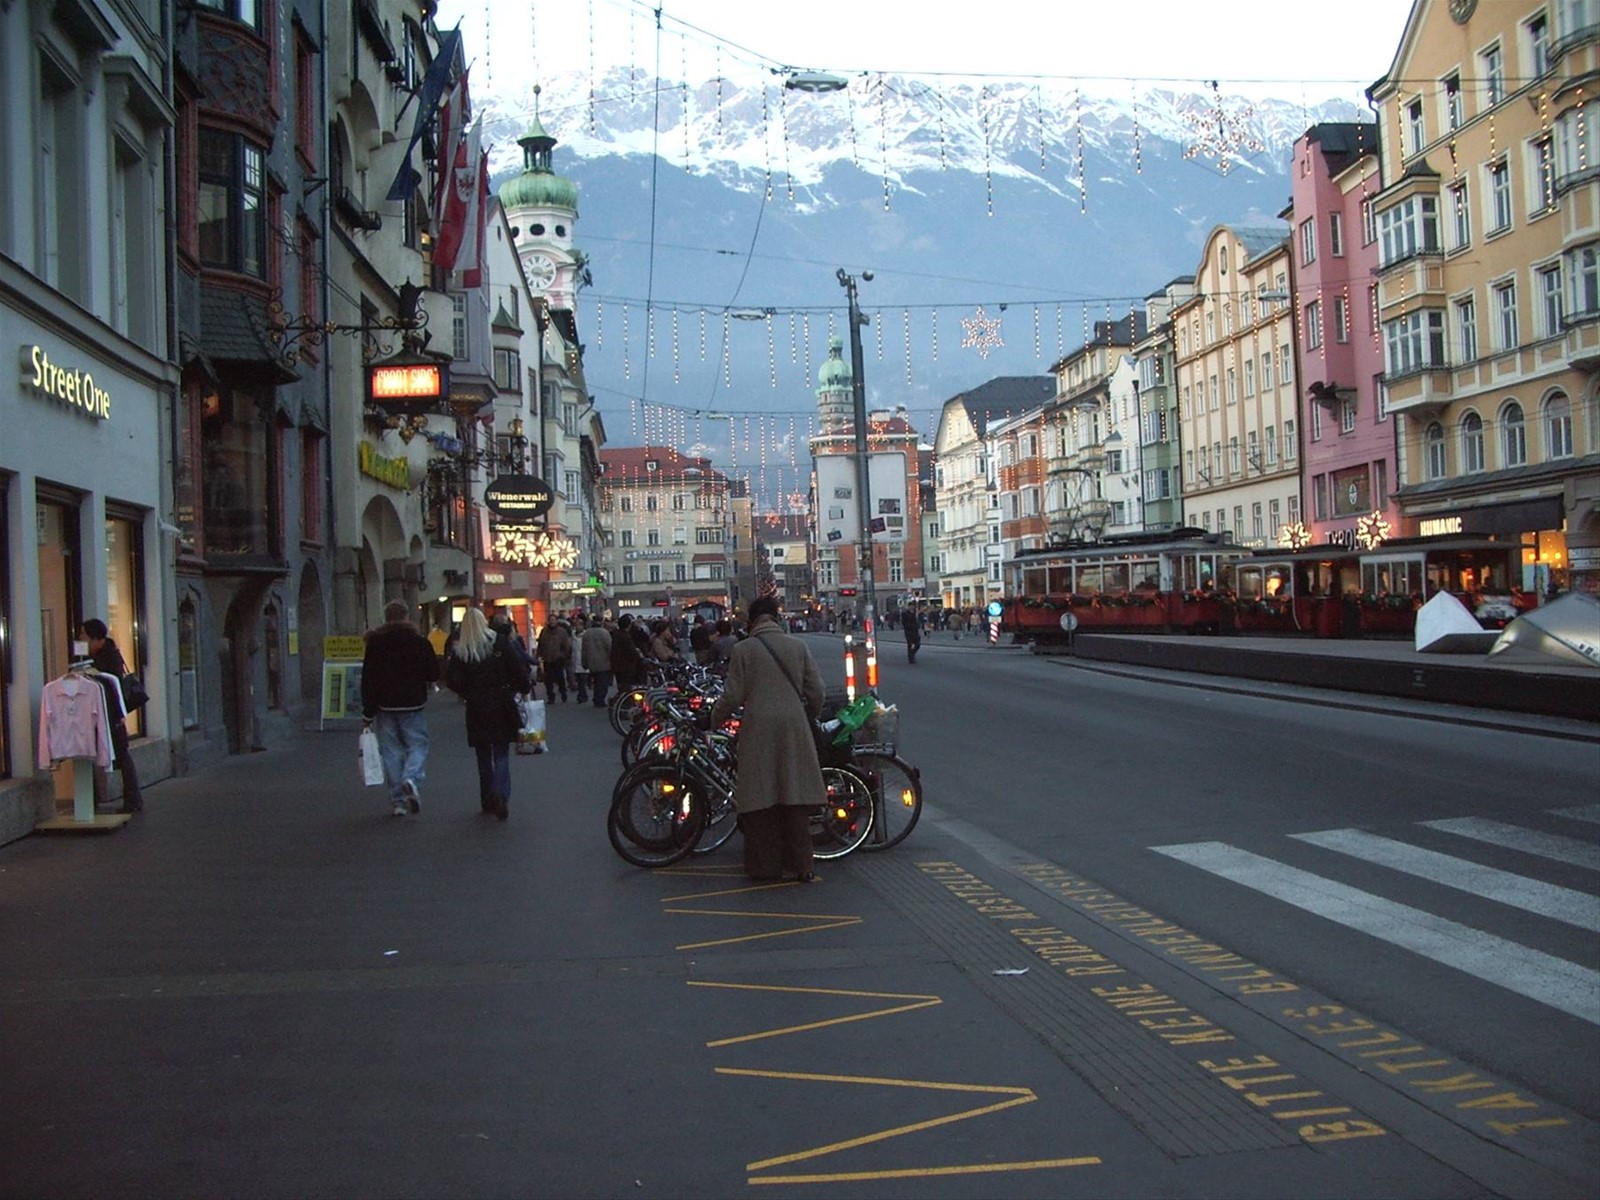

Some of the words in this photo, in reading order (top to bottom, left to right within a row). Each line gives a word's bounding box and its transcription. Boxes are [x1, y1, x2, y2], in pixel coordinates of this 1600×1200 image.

[32, 345, 82, 407] Street
[84, 373, 111, 420] One
[487, 491, 548, 501] Wienerwald
[1324, 528, 1369, 551] TYROL
[1420, 516, 1463, 537] HUMANIC
[1091, 983, 1235, 1045] KEINE
[1199, 1055, 1387, 1143] BITTE
